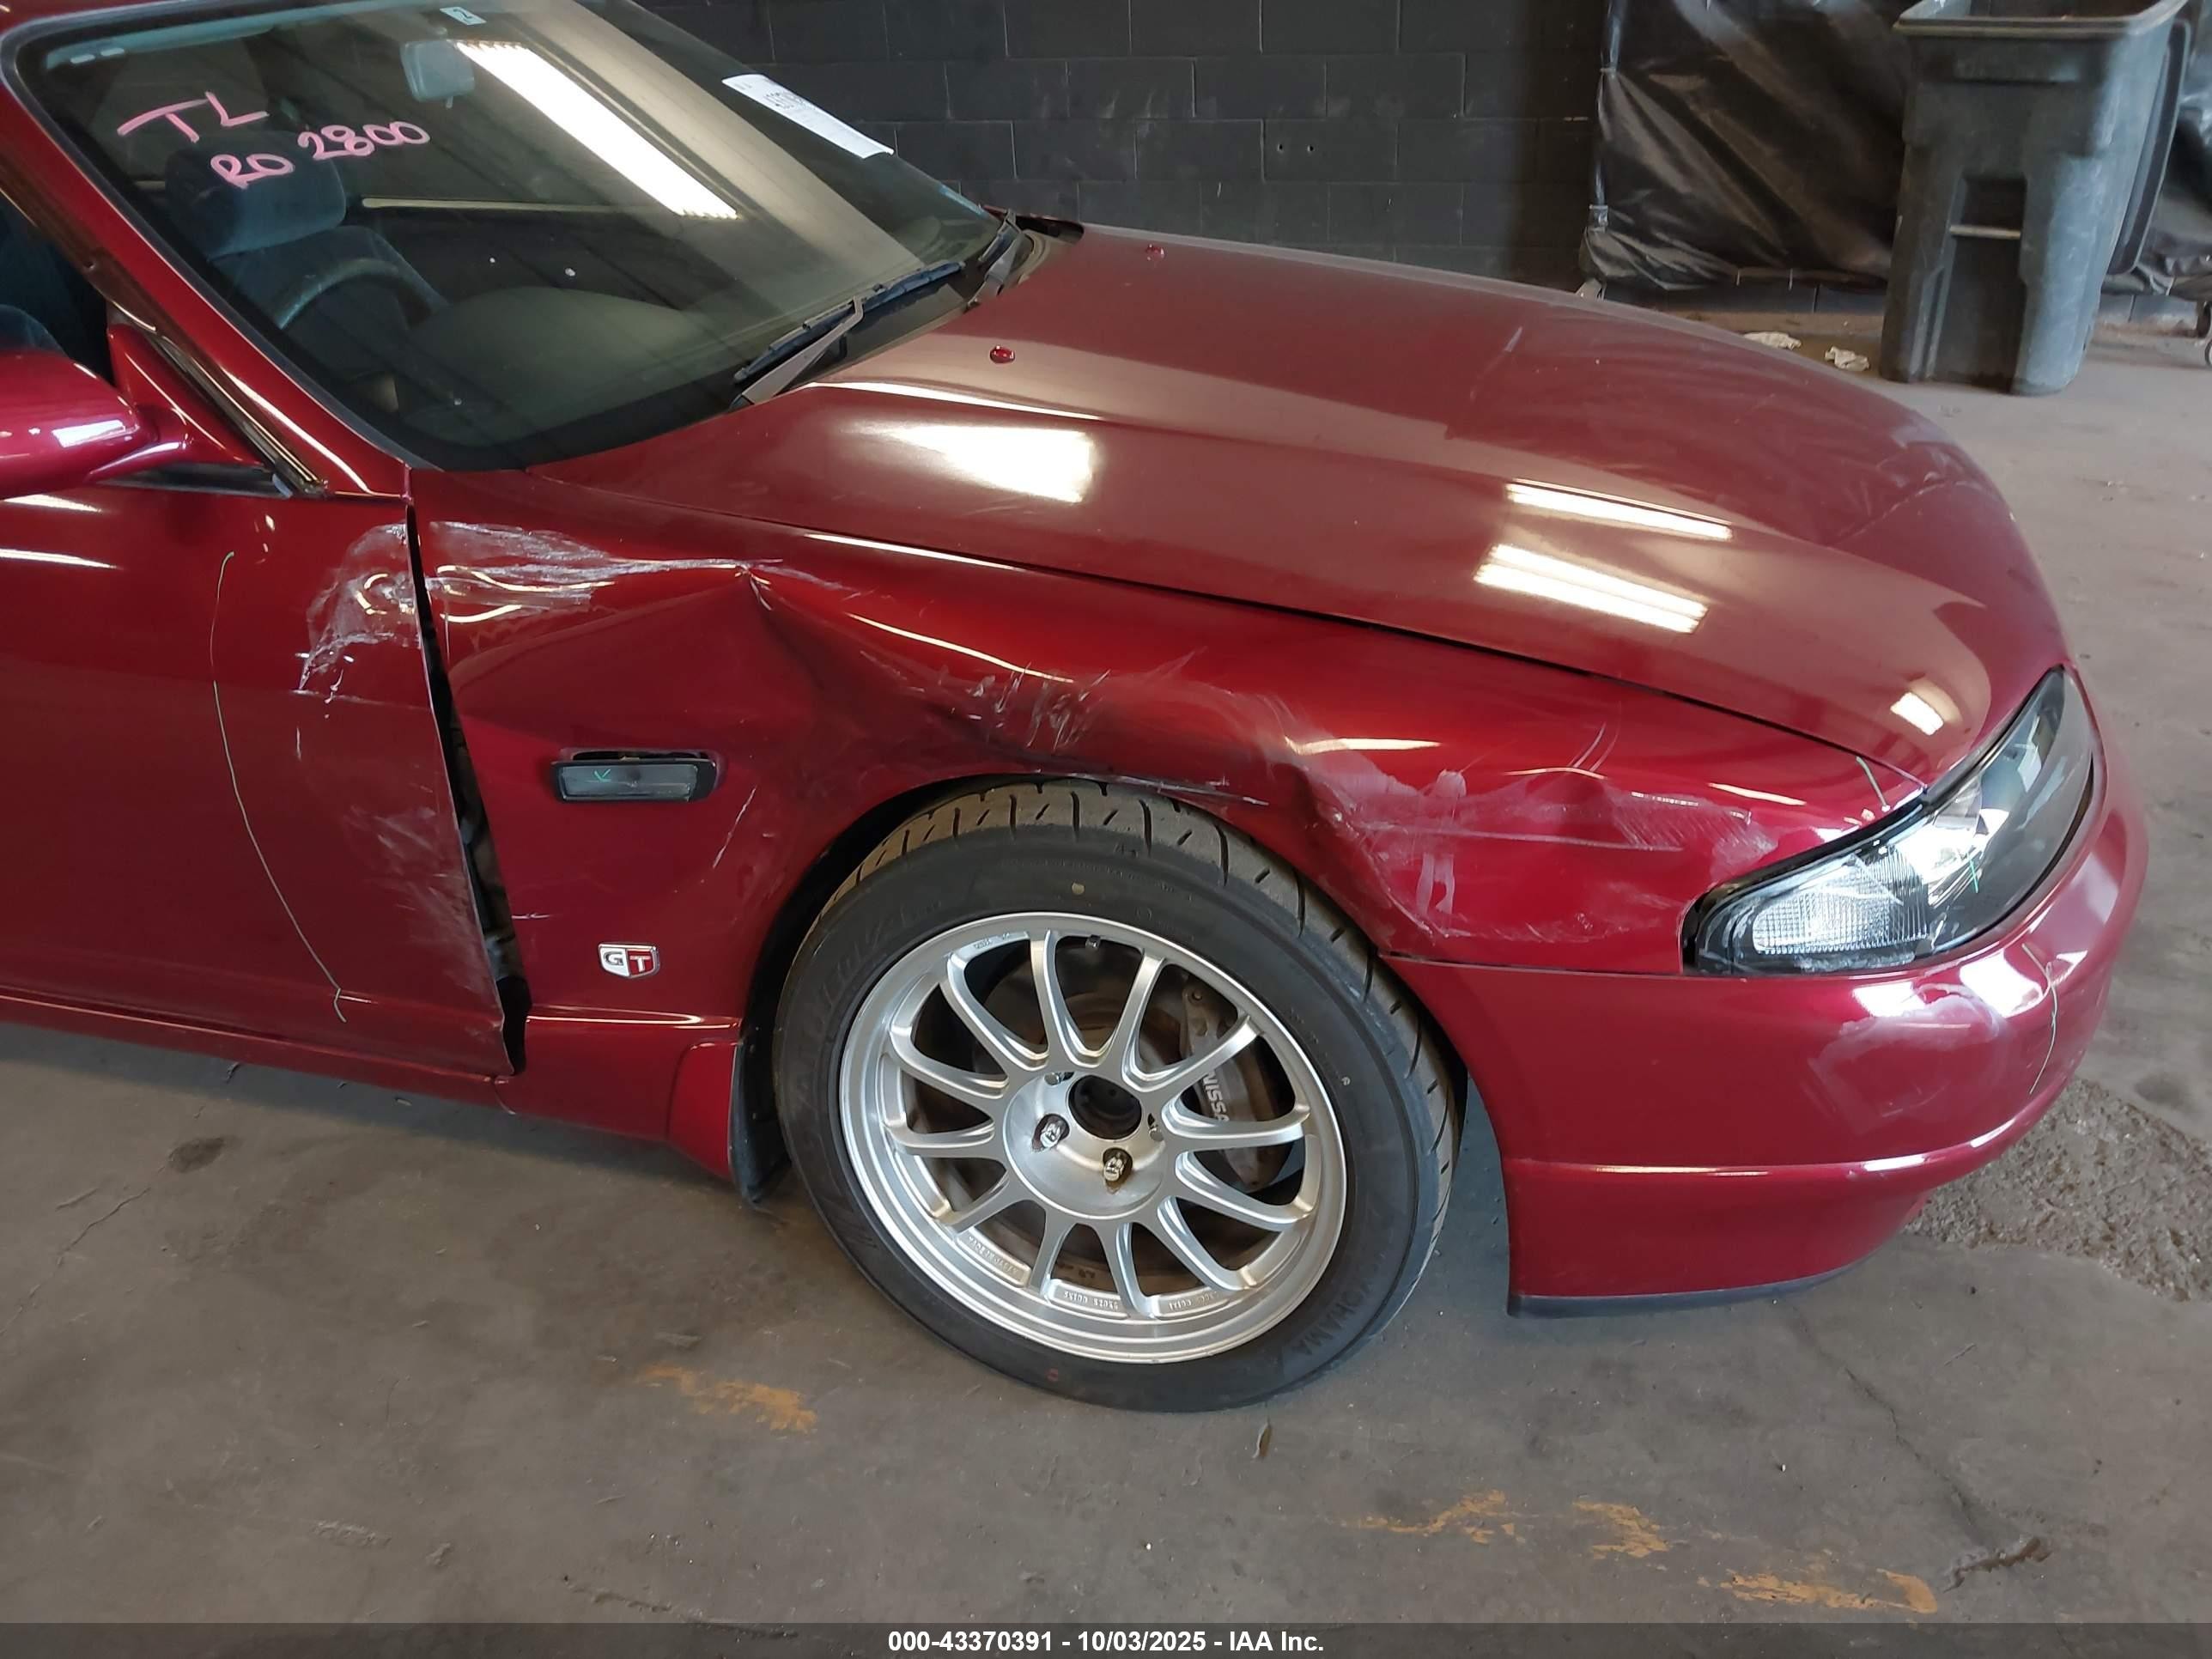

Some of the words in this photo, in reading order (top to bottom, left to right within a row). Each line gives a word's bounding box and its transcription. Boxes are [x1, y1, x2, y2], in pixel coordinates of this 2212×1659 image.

[117, 90, 270, 143] TL
[297, 121, 430, 161] 2800
[603, 950, 653, 974] GT
